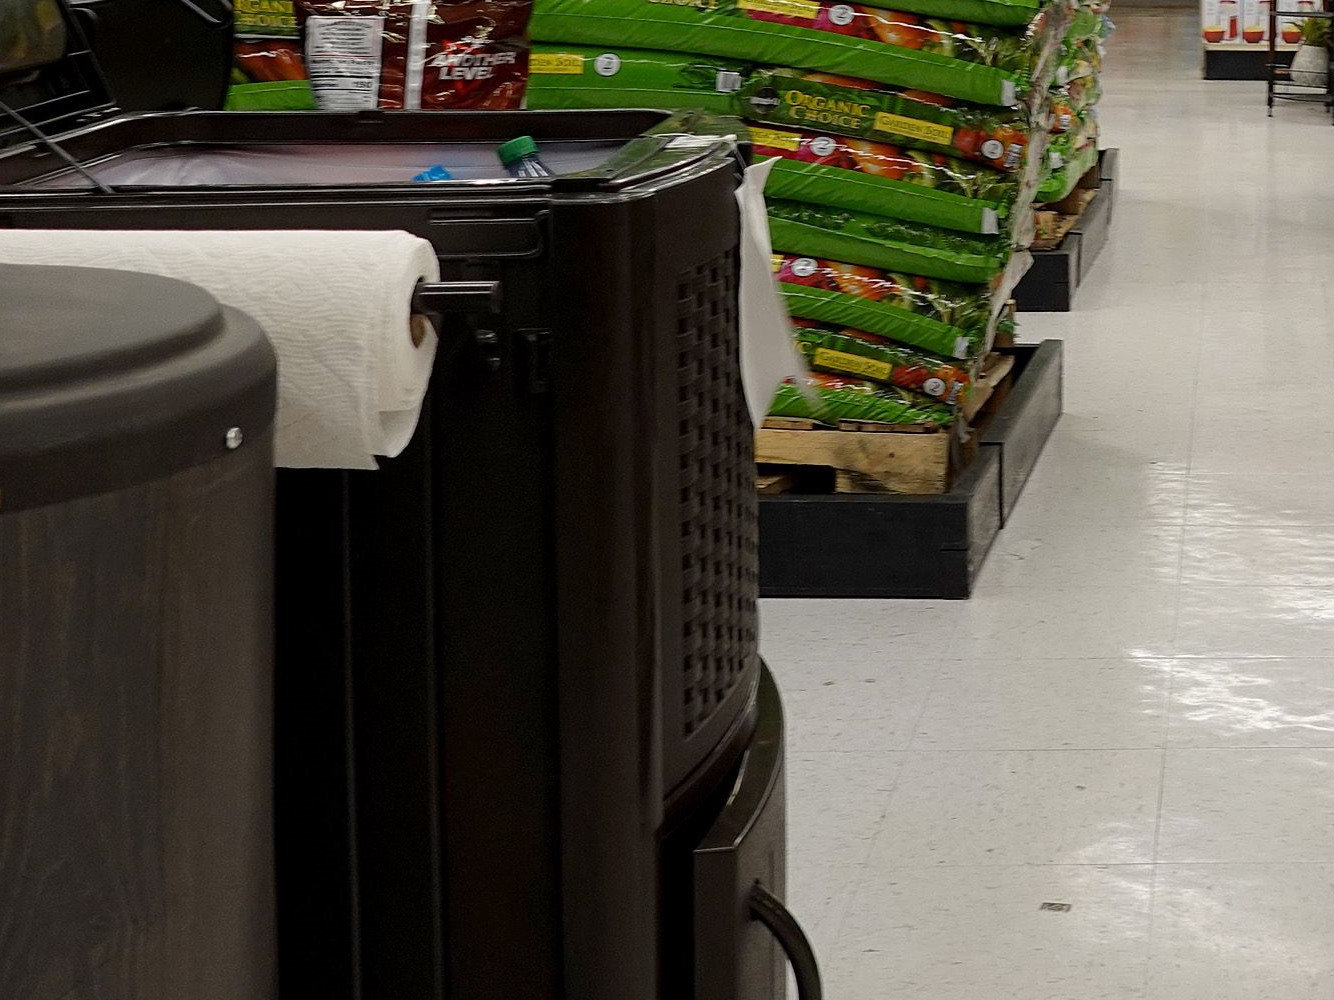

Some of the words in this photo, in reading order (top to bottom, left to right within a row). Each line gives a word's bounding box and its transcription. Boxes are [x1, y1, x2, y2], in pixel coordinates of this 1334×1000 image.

[428, 51, 517, 67] ANOTHER
[440, 67, 494, 80] LEVEL
[785, 90, 871, 118] ORGANIC
[788, 105, 861, 129] CHOICE
